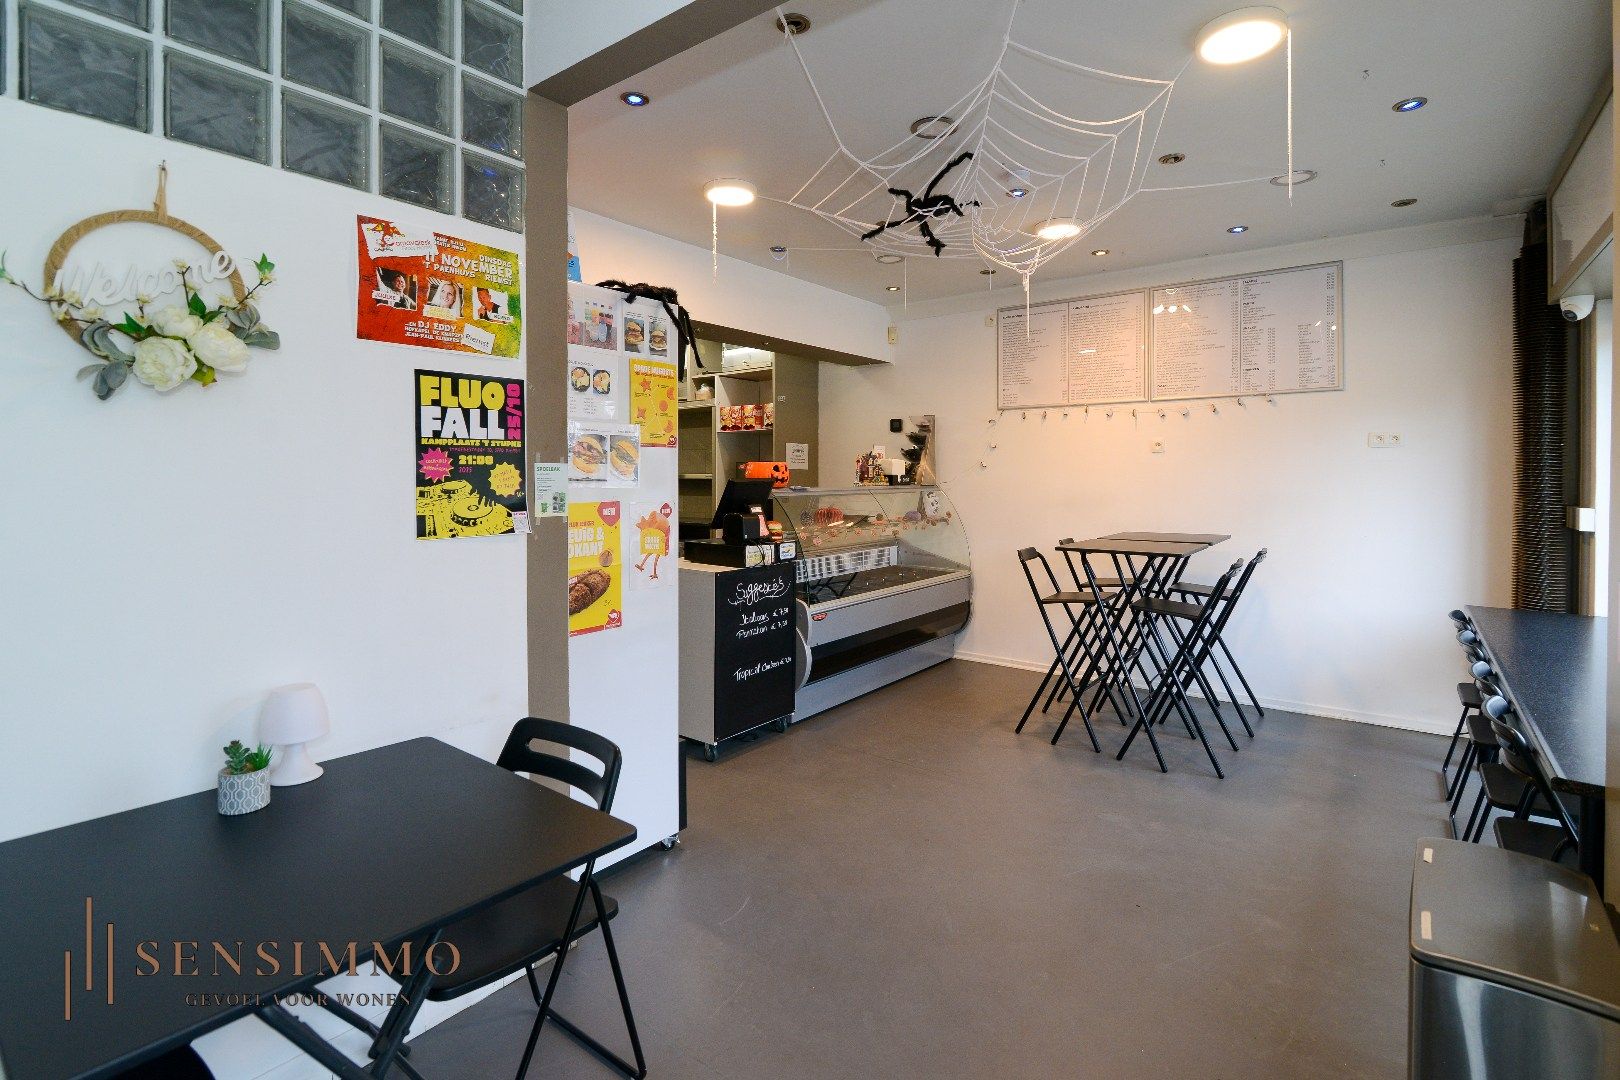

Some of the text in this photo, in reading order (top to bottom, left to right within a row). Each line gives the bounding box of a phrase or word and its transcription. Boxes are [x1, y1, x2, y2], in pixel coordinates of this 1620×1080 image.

[441, 253, 513, 280] NOVEMBER
[479, 254, 512, 268] DINSDAG
[53, 250, 237, 307] Welcome
[418, 320, 430, 329] DJ
[433, 322, 457, 333] EDDY
[419, 374, 506, 411] FLUO
[420, 405, 505, 440] FALL
[506, 383, 523, 441] 25/10
[458, 454, 494, 465] 21:00
[602, 508, 616, 516] NEW
